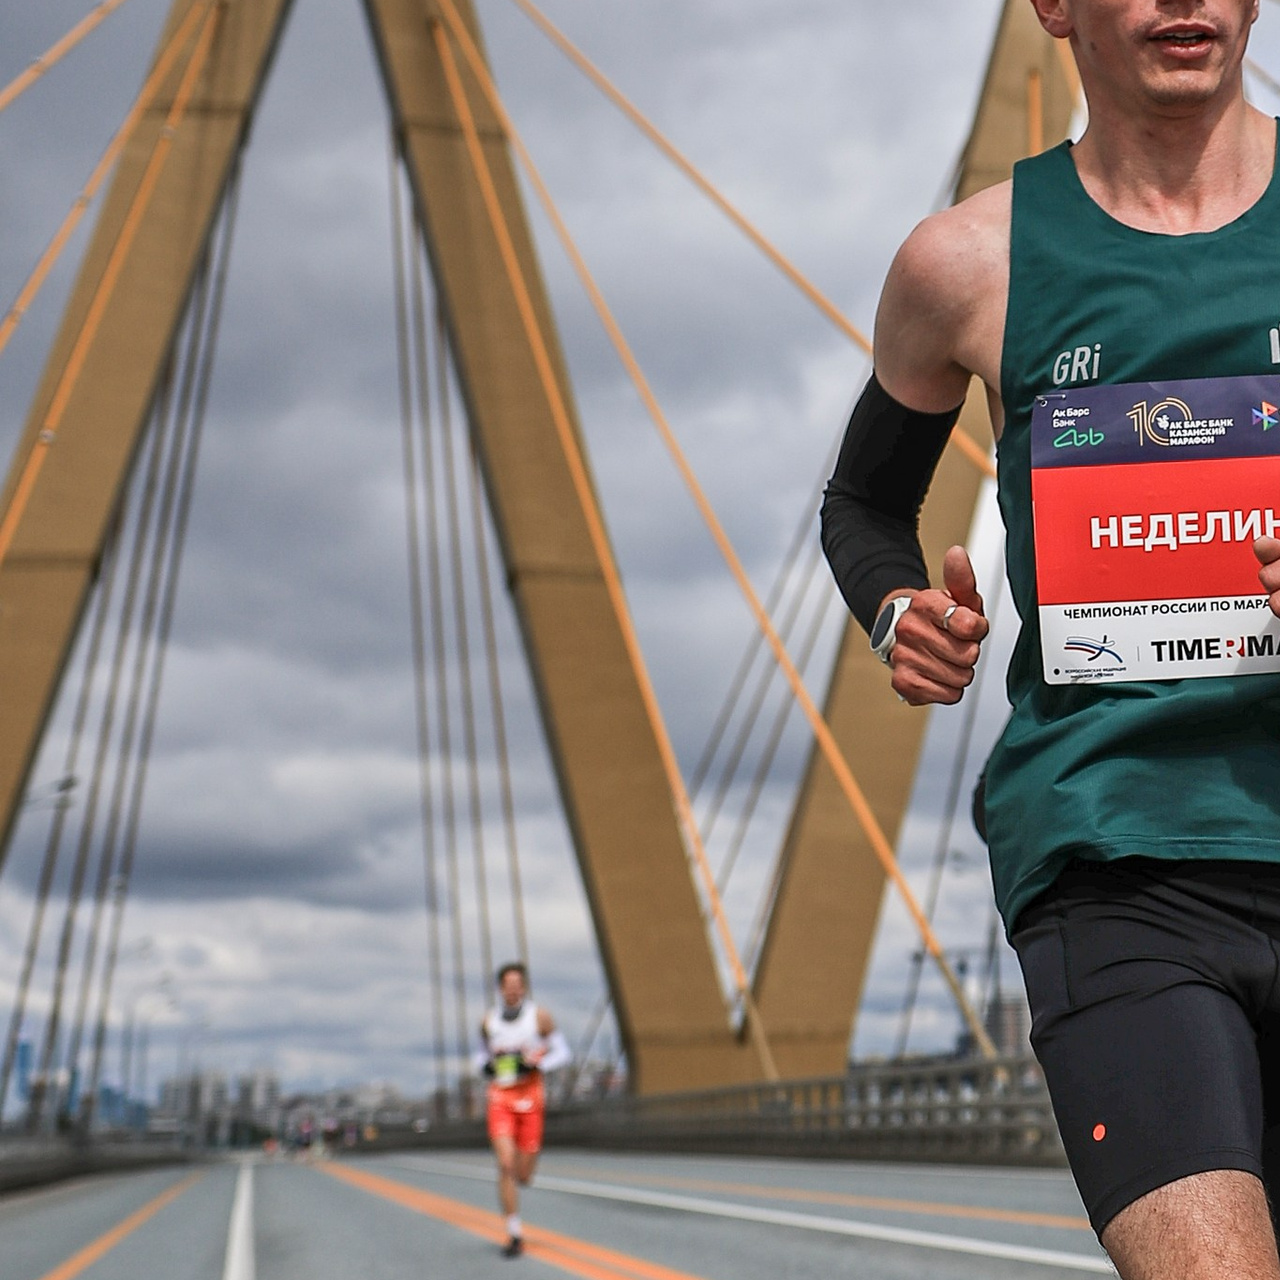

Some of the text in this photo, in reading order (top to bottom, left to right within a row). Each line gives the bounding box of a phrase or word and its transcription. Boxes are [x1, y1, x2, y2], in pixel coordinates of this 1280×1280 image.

[1052, 408, 1090, 418] Ак Барс
[1053, 418, 1076, 428] Банк
[1169, 418, 1234, 430] АК БАРС БАНК
[1169, 427, 1226, 438] КАЗАНСКИЙ
[1169, 436, 1215, 446] МАРАФОН
[1064, 598, 1270, 620] ЧЕМПИОНАТ РОССИИ ПО МАРА
